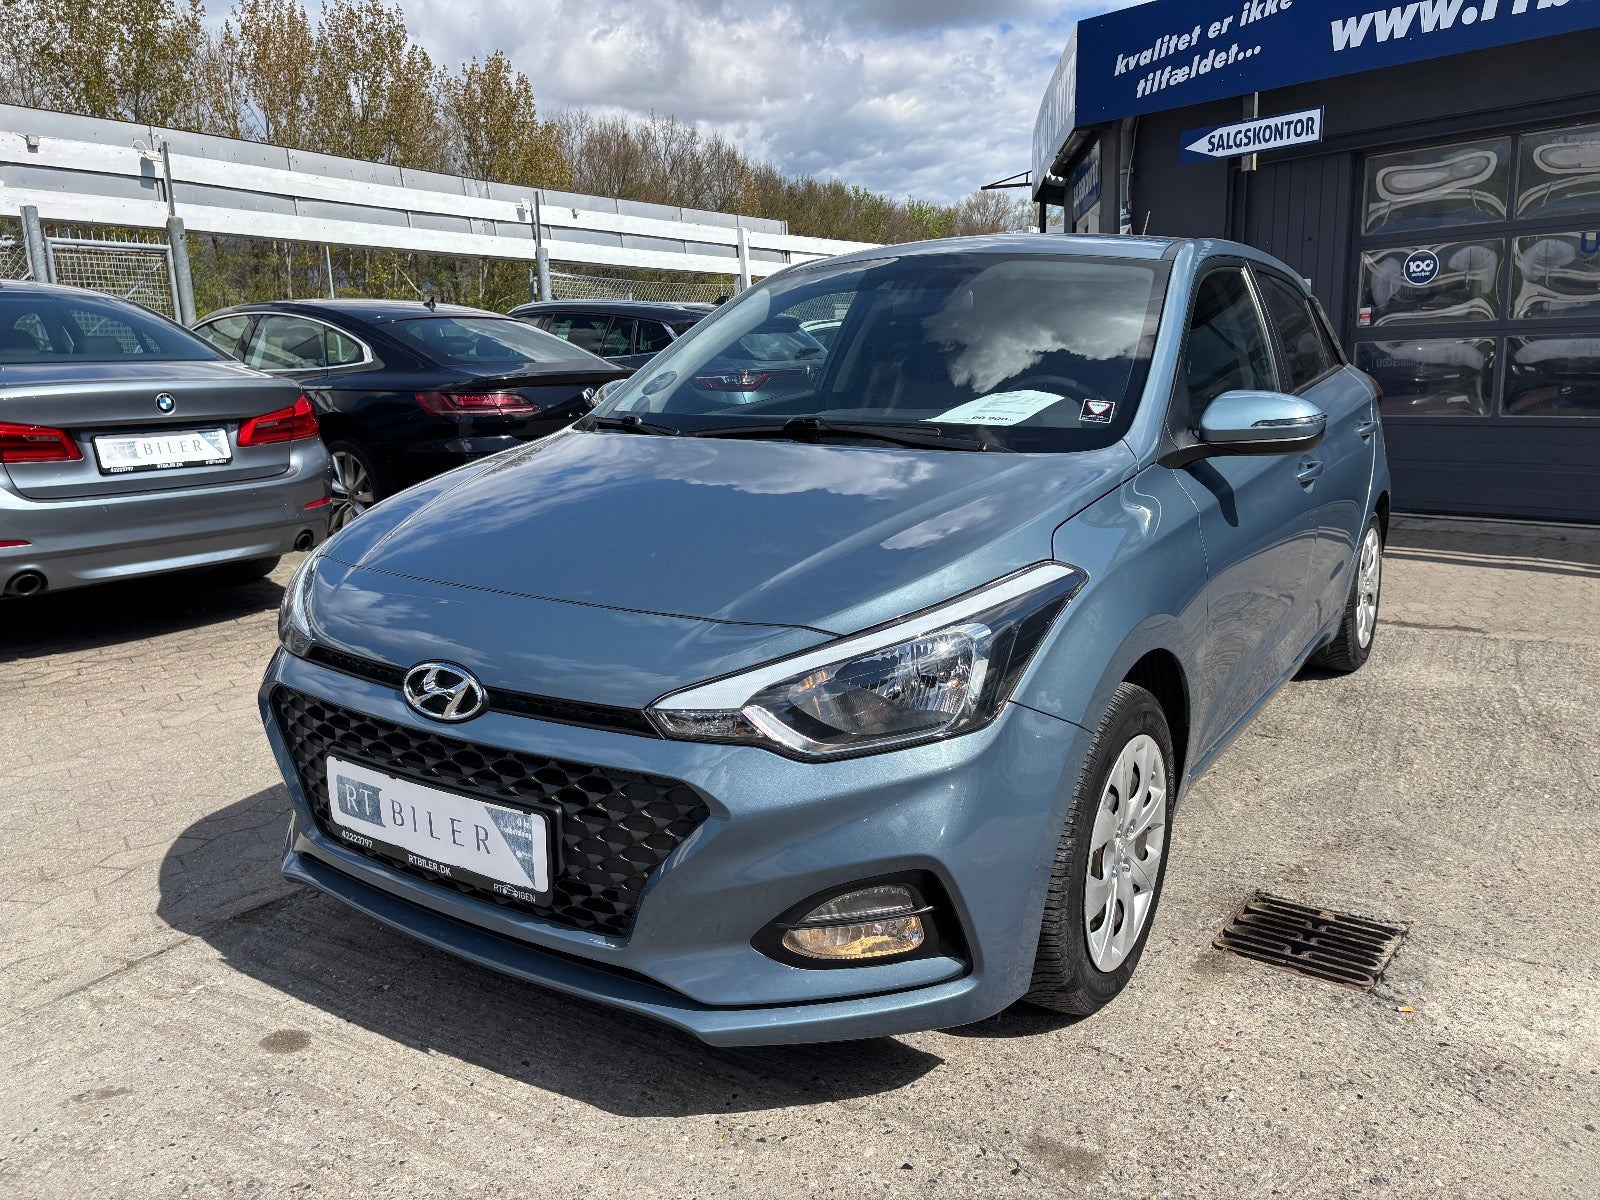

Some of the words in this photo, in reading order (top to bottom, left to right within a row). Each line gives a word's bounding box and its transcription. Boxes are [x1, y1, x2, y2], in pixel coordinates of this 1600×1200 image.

[1114, 25, 1201, 77] kvalitet
[1207, 15, 1234, 39] er
[1136, 43, 1262, 99] tilfældet...
[1207, 116, 1315, 153] SALGSKONTOR
[143, 439, 203, 456] BILER
[345, 783, 373, 816] RT
[390, 798, 491, 855] BILER
[341, 830, 373, 849] 42223797
[408, 853, 452, 877] RTBILER.DK
